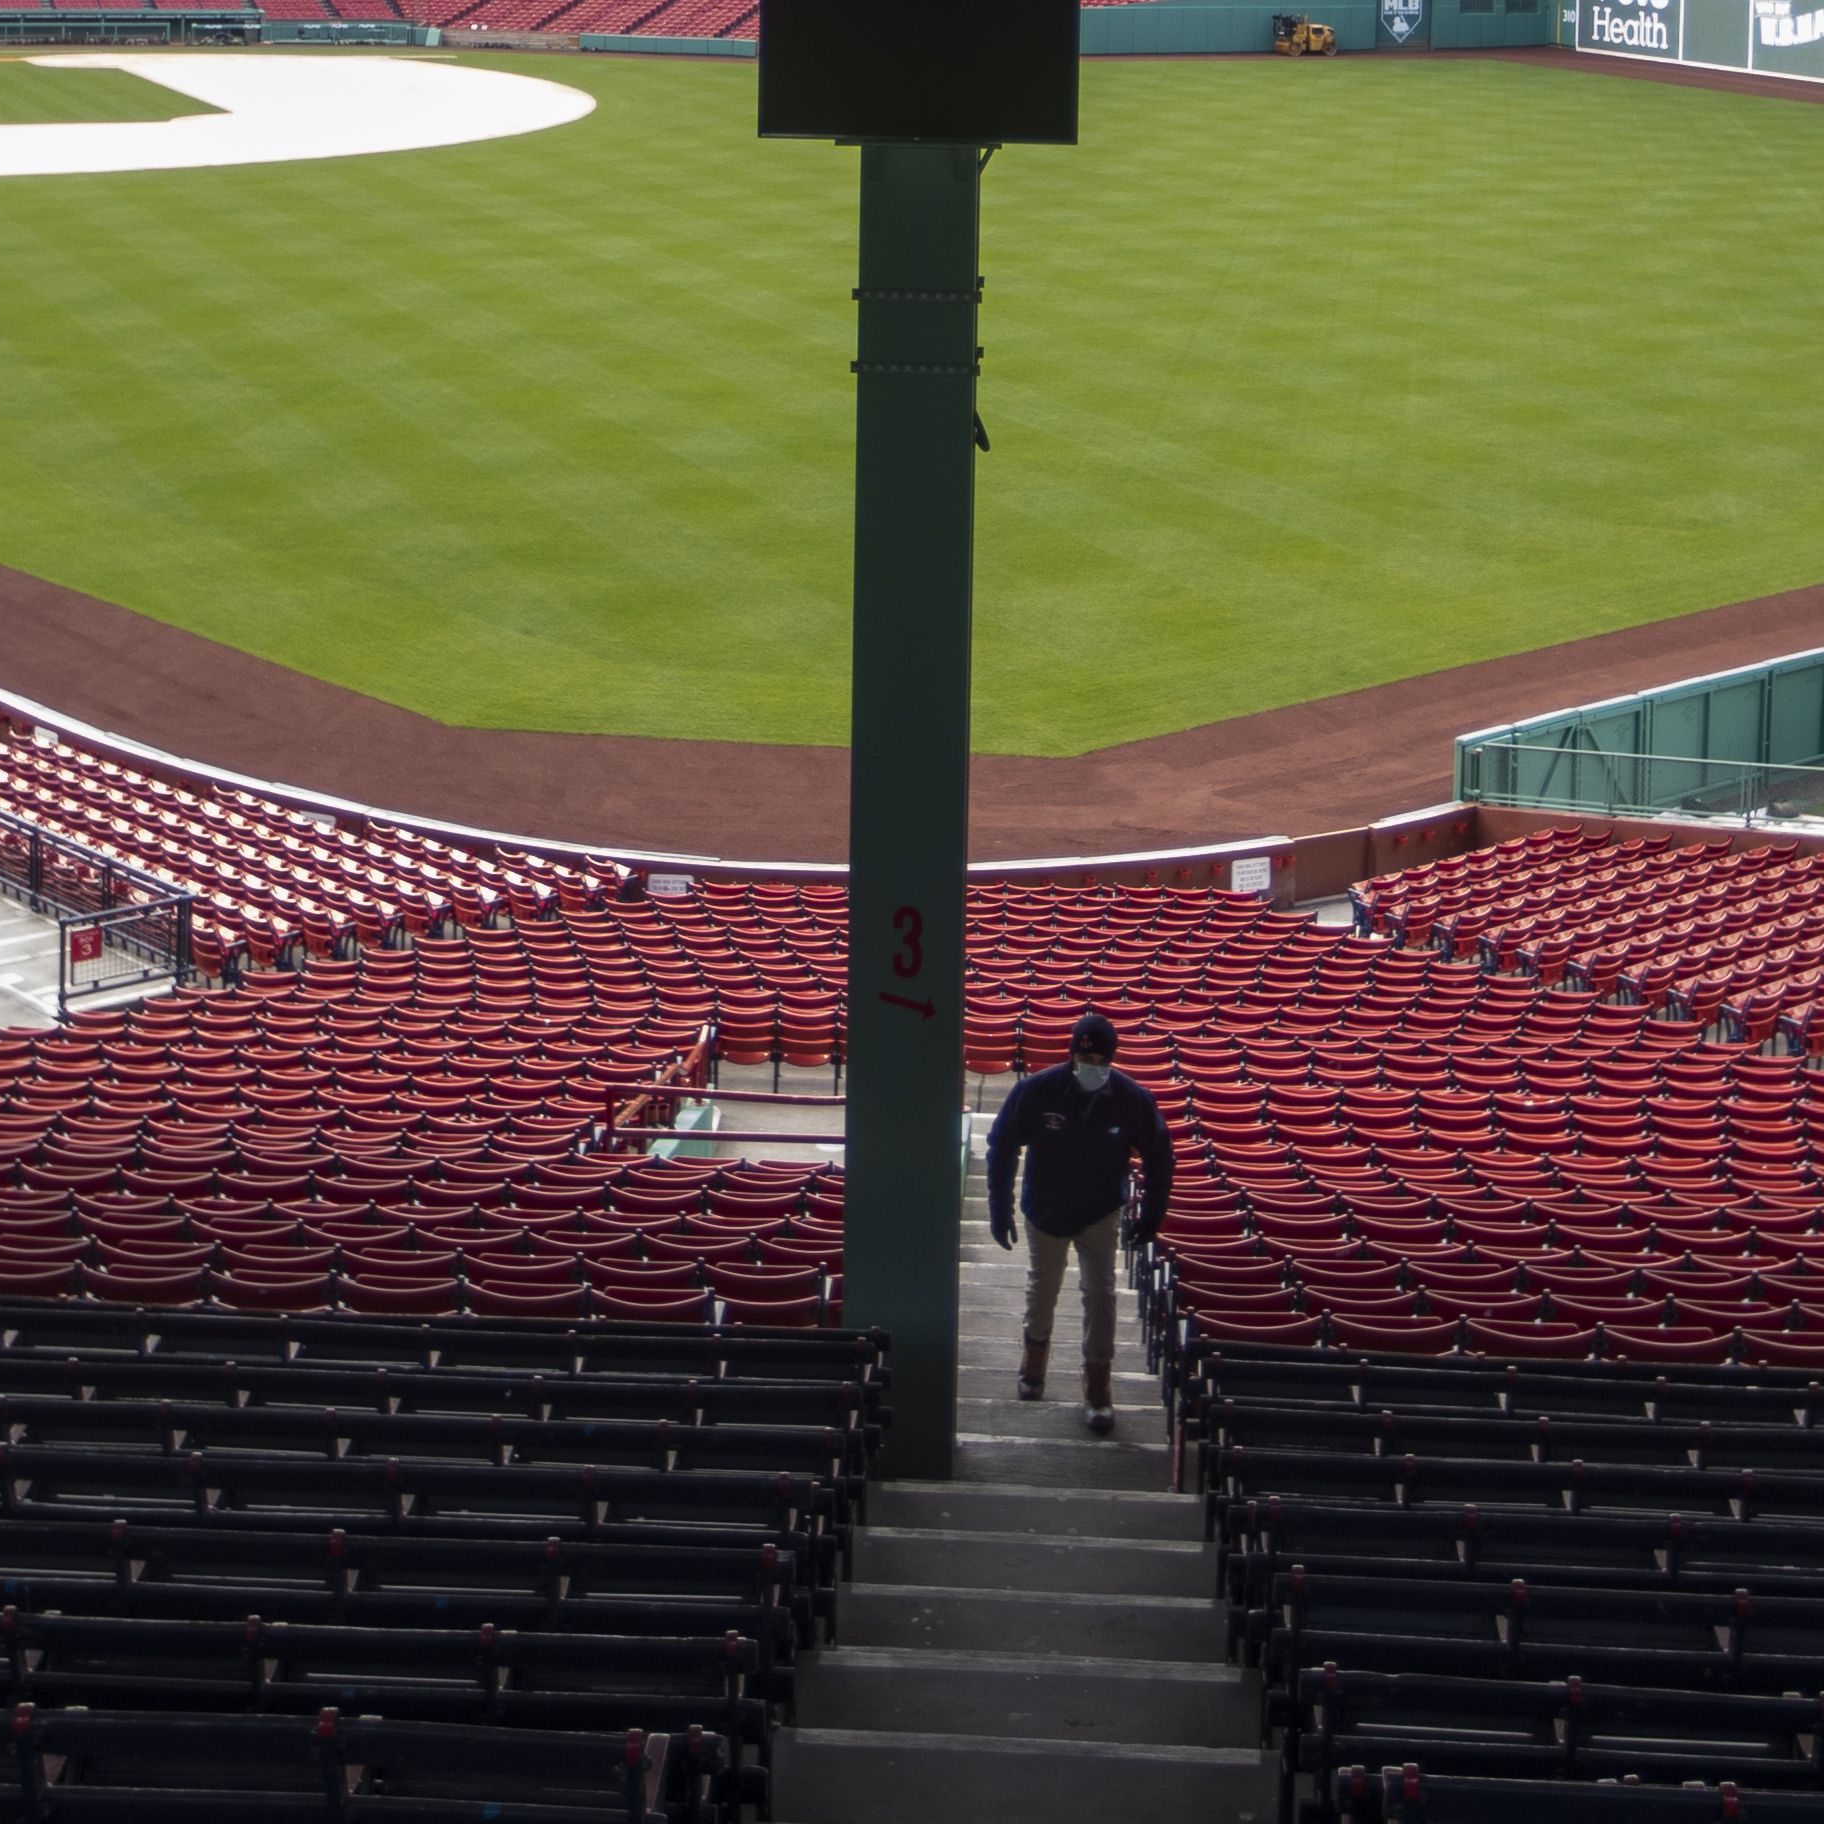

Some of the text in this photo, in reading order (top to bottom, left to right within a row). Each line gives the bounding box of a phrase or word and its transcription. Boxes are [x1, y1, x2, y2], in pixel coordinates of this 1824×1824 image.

[1562, 10, 1576, 24] 310
[1591, 5, 1669, 50] Health
[892, 905, 924, 977] 3
